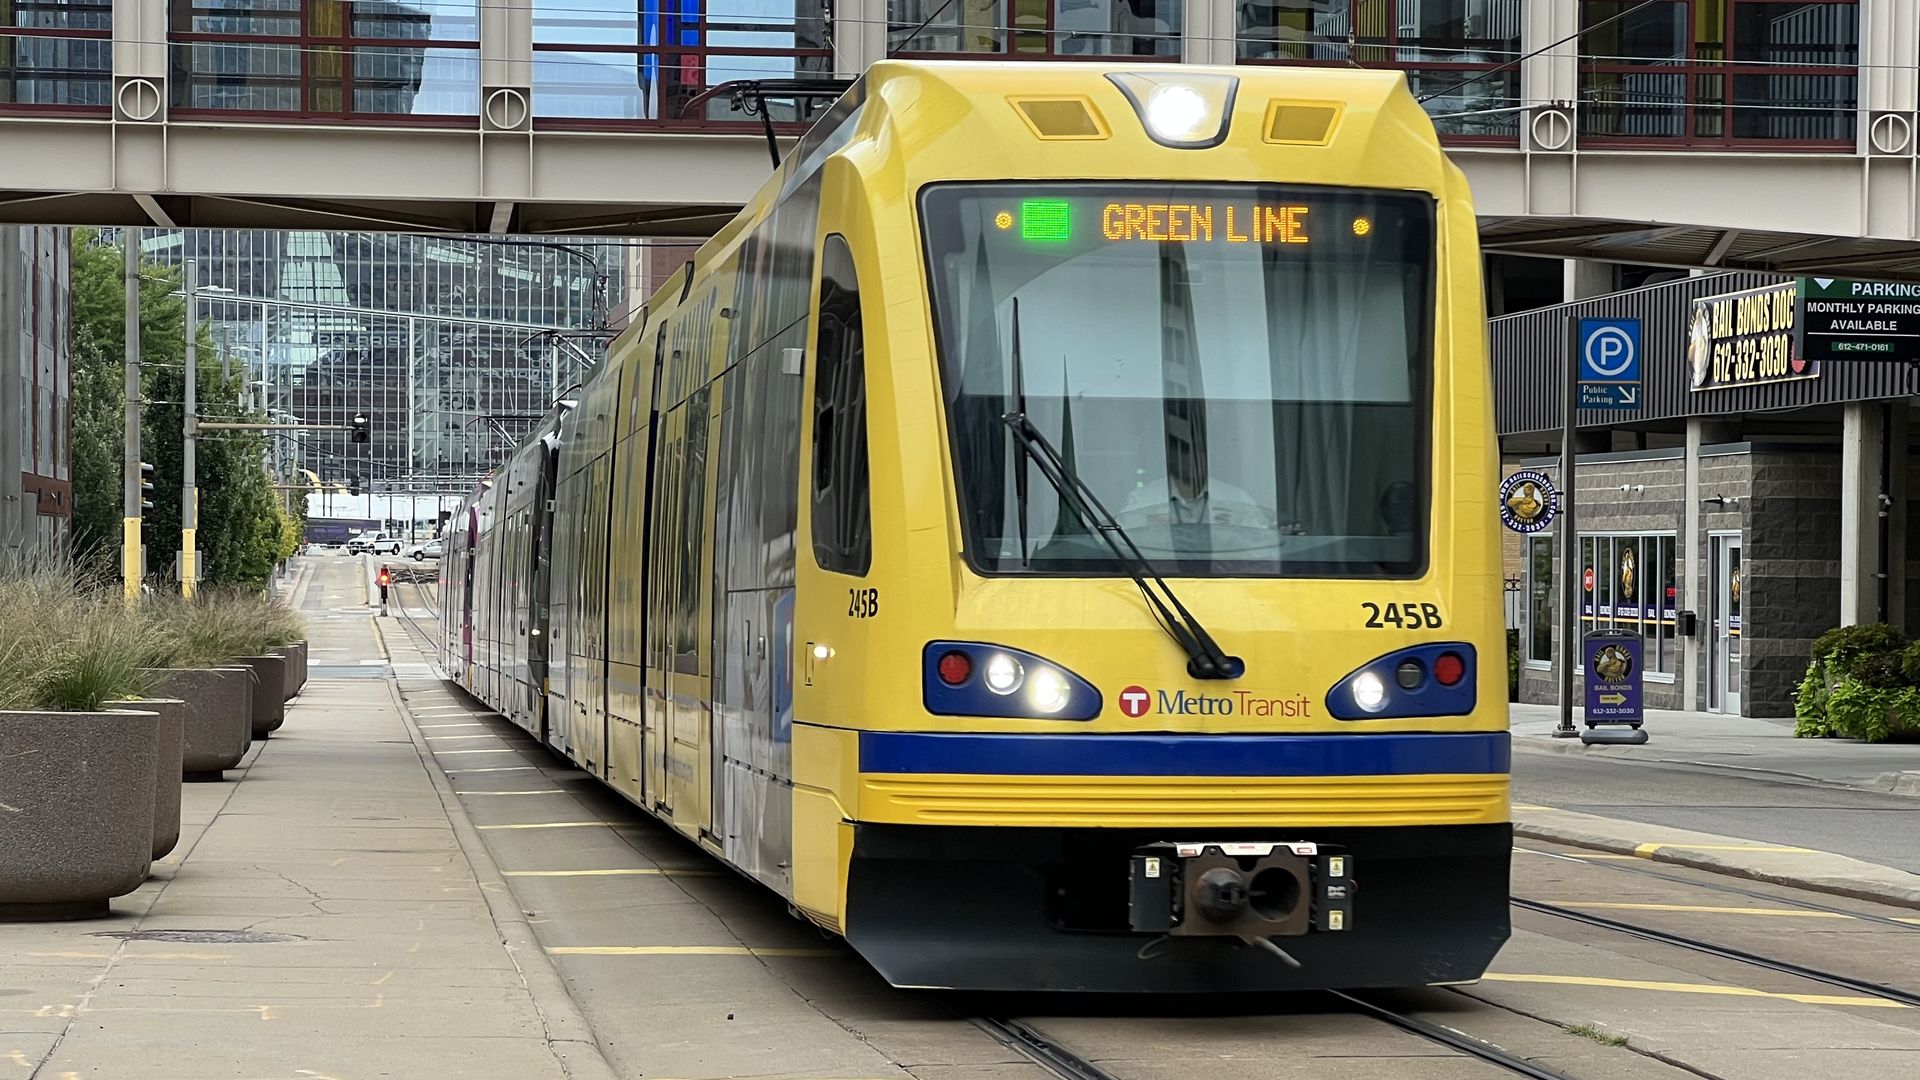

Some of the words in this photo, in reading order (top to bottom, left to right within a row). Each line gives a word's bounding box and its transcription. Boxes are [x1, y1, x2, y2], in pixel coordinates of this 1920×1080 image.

[1103, 203, 1212, 242] GREEN
[1226, 206, 1309, 243] LINE
[1851, 283, 1920, 297] PARKING
[1712, 299, 1734, 340] BAIL
[1736, 292, 1771, 336] BONDS
[1772, 287, 1797, 331] DOC
[1807, 302, 1865, 313] MONTHLY
[1867, 303, 1920, 315] PARKING
[1830, 319, 1898, 331] AVAILABLE
[1713, 333, 1788, 383] 612-332-3030
[1583, 384, 1608, 394] Public
[1583, 394, 1613, 405] Parking
[848, 588, 879, 618] 245B
[1361, 602, 1443, 630] 245B
[1156, 689, 1233, 716] Metro
[1233, 690, 1311, 718] Transit
